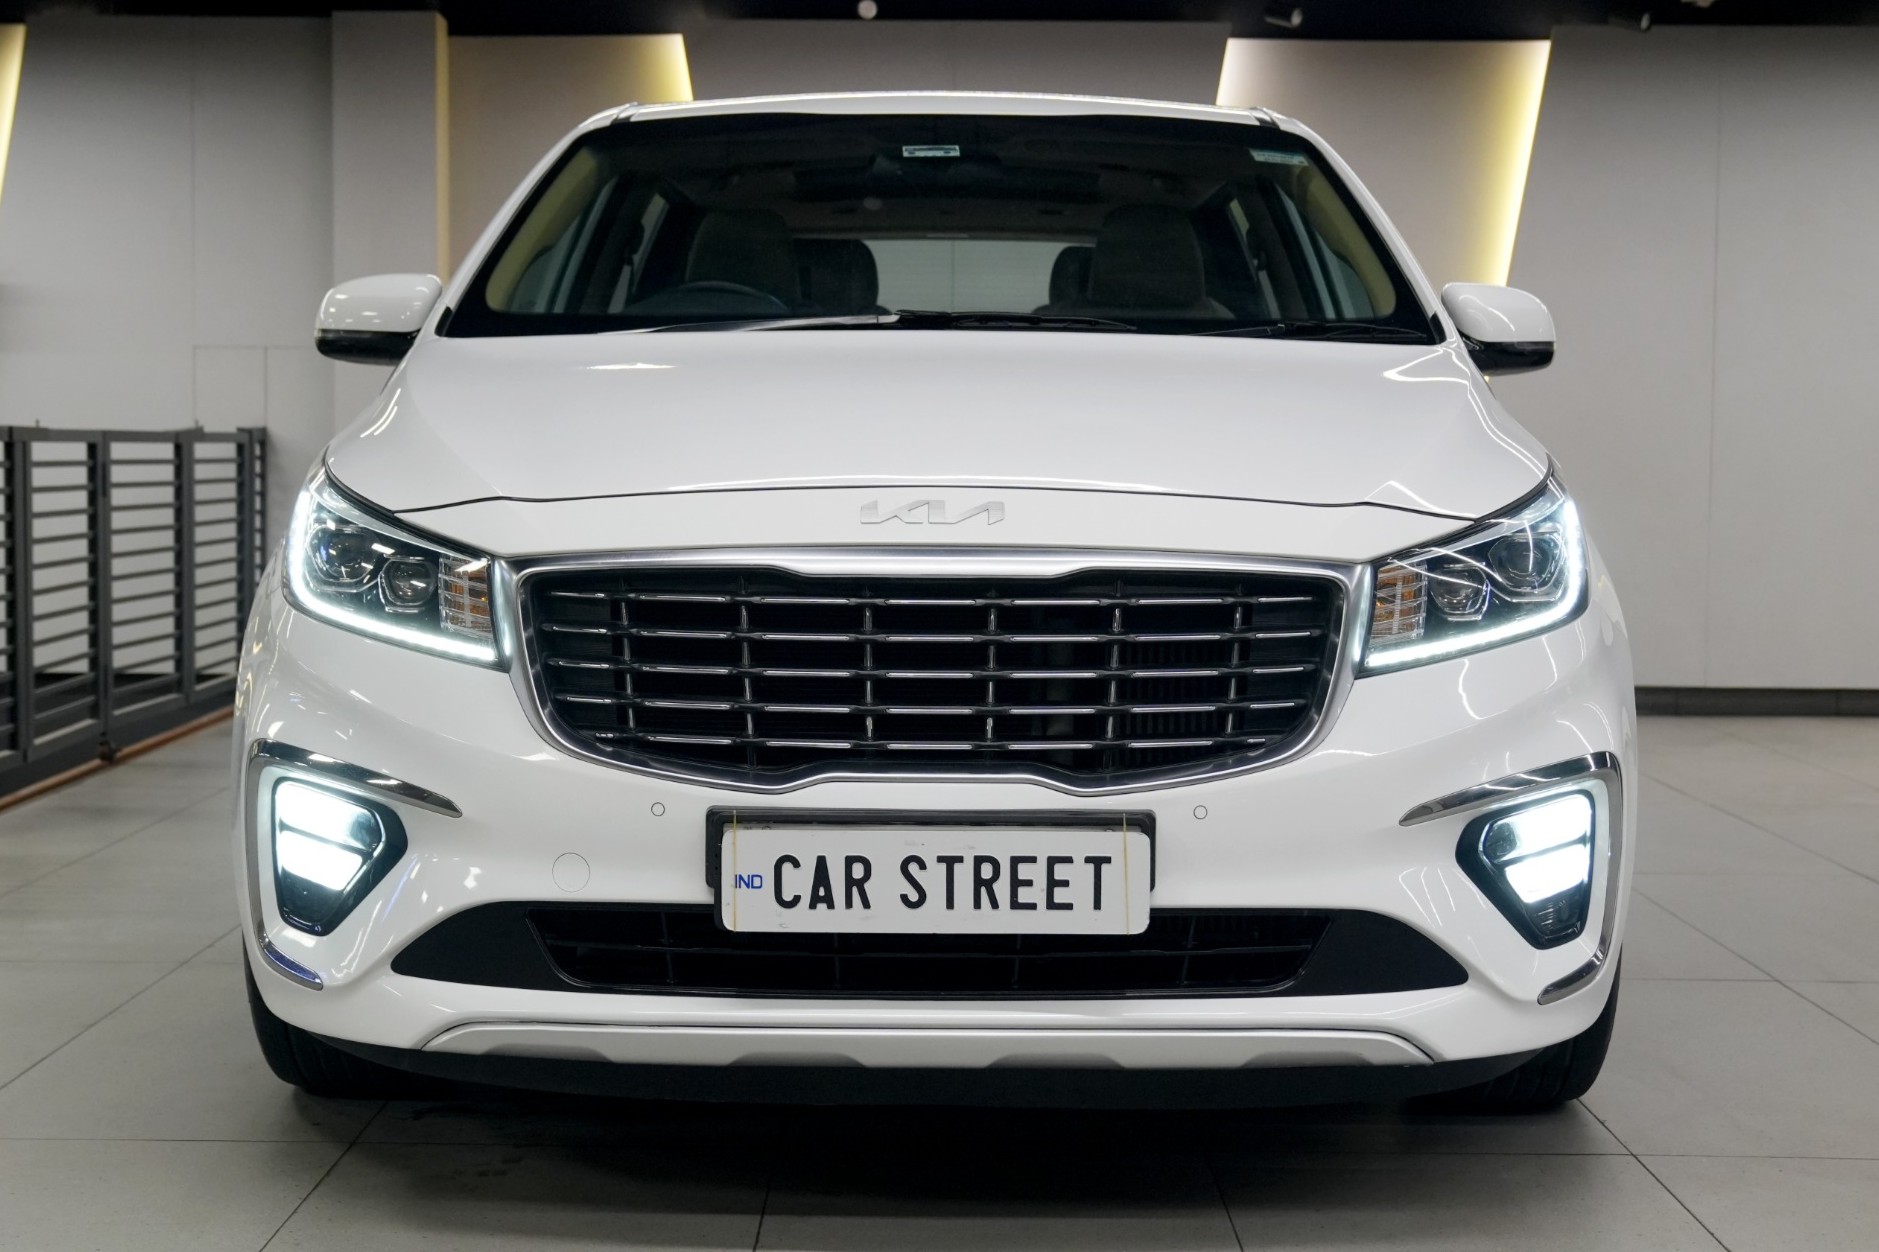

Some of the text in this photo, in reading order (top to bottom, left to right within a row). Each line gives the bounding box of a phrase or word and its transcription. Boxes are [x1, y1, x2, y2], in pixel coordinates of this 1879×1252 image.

[860, 499, 1005, 526] KIA
[734, 873, 763, 890] IND
[773, 853, 1112, 911] CAR STREET
